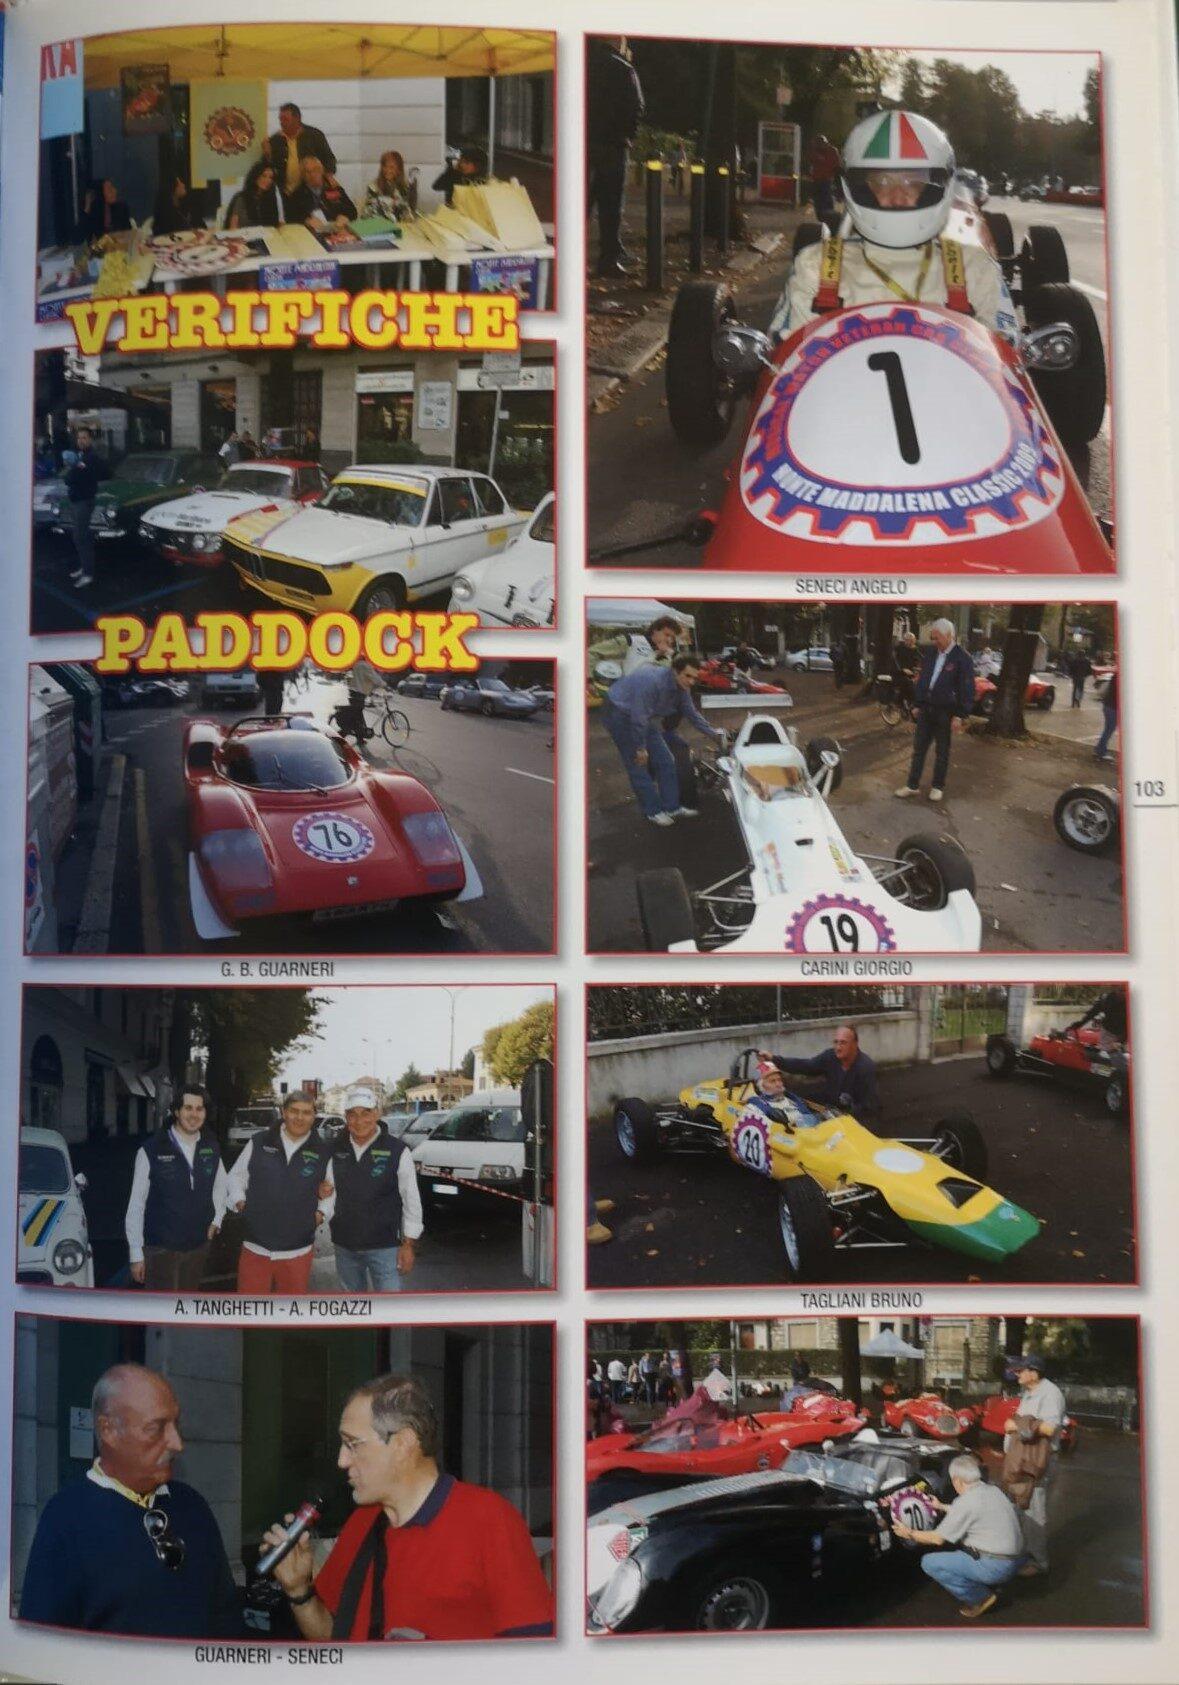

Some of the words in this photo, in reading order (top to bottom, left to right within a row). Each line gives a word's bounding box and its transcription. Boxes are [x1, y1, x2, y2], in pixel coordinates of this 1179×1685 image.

[66, 291, 519, 354] VERIFICHE
[867, 351, 921, 465] 1
[815, 486, 950, 514] MADDALENA
[951, 468, 1024, 507] CLASSIC
[796, 578, 846, 594] SENECI
[851, 579, 908, 594] ANGELO
[97, 612, 480, 671] PADDOCK
[1134, 780, 1165, 797] 103
[312, 821, 354, 851] 76
[819, 913, 859, 952] 19
[221, 961, 237, 977] G.
[241, 961, 254, 977] B.
[258, 961, 335, 977] GUARNERI
[801, 960, 849, 976] CARINI
[854, 960, 913, 976] GIORGIO
[743, 1129, 760, 1167] 20
[175, 1297, 188, 1314] A.
[192, 1298, 274, 1315] TANGHETTI
[289, 1300, 304, 1316] A.
[308, 1299, 372, 1316] FOGAZZI
[801, 1291, 867, 1308] TAGLIANI
[871, 1291, 923, 1308] BRUNO
[195, 1645, 272, 1664] GUARNERI
[288, 1647, 344, 1665] SENECI
